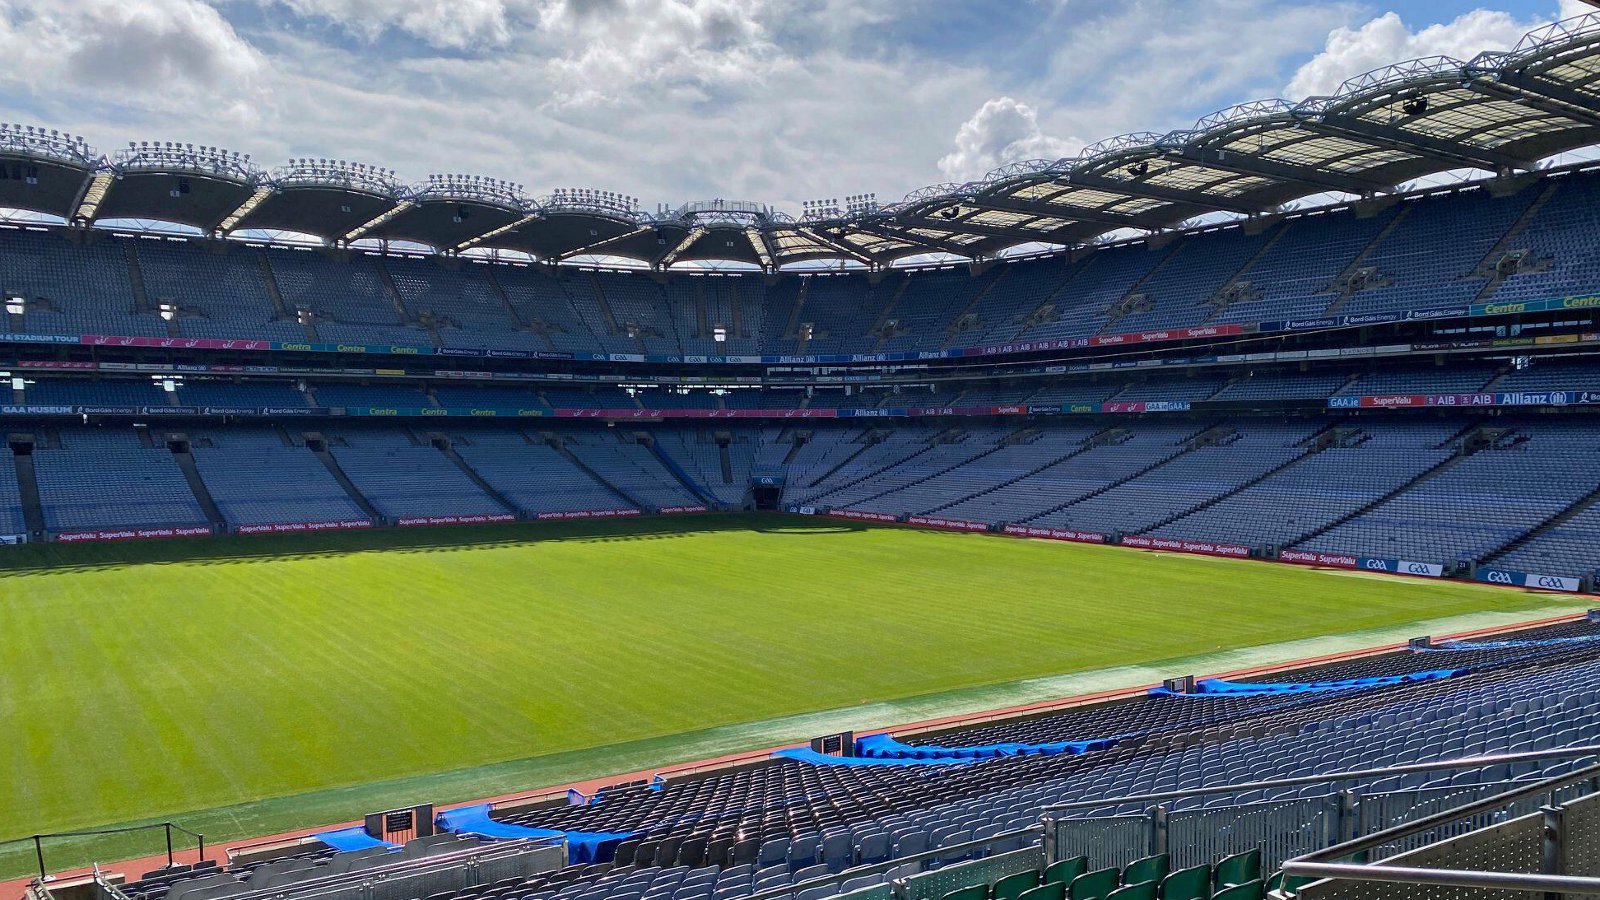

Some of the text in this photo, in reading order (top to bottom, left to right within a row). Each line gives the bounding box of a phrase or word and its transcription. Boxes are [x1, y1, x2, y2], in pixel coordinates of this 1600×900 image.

[1485, 304, 1525, 314] Centra
[14, 334, 53, 342] STADIUM
[1099, 327, 1216, 344] SuperValu SuperValu SuperValu
[282, 342, 418, 355] Centra Centra Centra
[919, 351, 939, 359] Allianz
[1330, 397, 1358, 407] GAA.ie
[1373, 396, 1411, 406] SuperValu
[1437, 395, 1491, 405] AIB AIB
[1502, 393, 1547, 405] Allianz
[27, 406, 72, 414] MUSEUM
[1071, 404, 1091, 412] Centra
[1147, 401, 1190, 410] GAA.ie GAA.ie
[369, 407, 397, 415] Centra
[421, 408, 447, 416] Centra
[471, 408, 496, 416] Centra
[855, 409, 878, 417] Allianz
[240, 525, 272, 533] SuperValu
[340, 520, 370, 528] SuperValu
[60, 527, 209, 541] SuperValu SuperValu SuperValu SuperValu
[1005, 525, 1103, 541] SuperValu SuperValu SuperValu SuperValu
[1123, 536, 1248, 554] SuperValu SuperValu SuperValu SuperValu
[1282, 550, 1356, 565] SuperValu SuperValu
[1367, 560, 1387, 570] GAA
[1408, 563, 1430, 574] GAA
[1488, 571, 1512, 584] GAA
[1538, 576, 1564, 589] GAA
